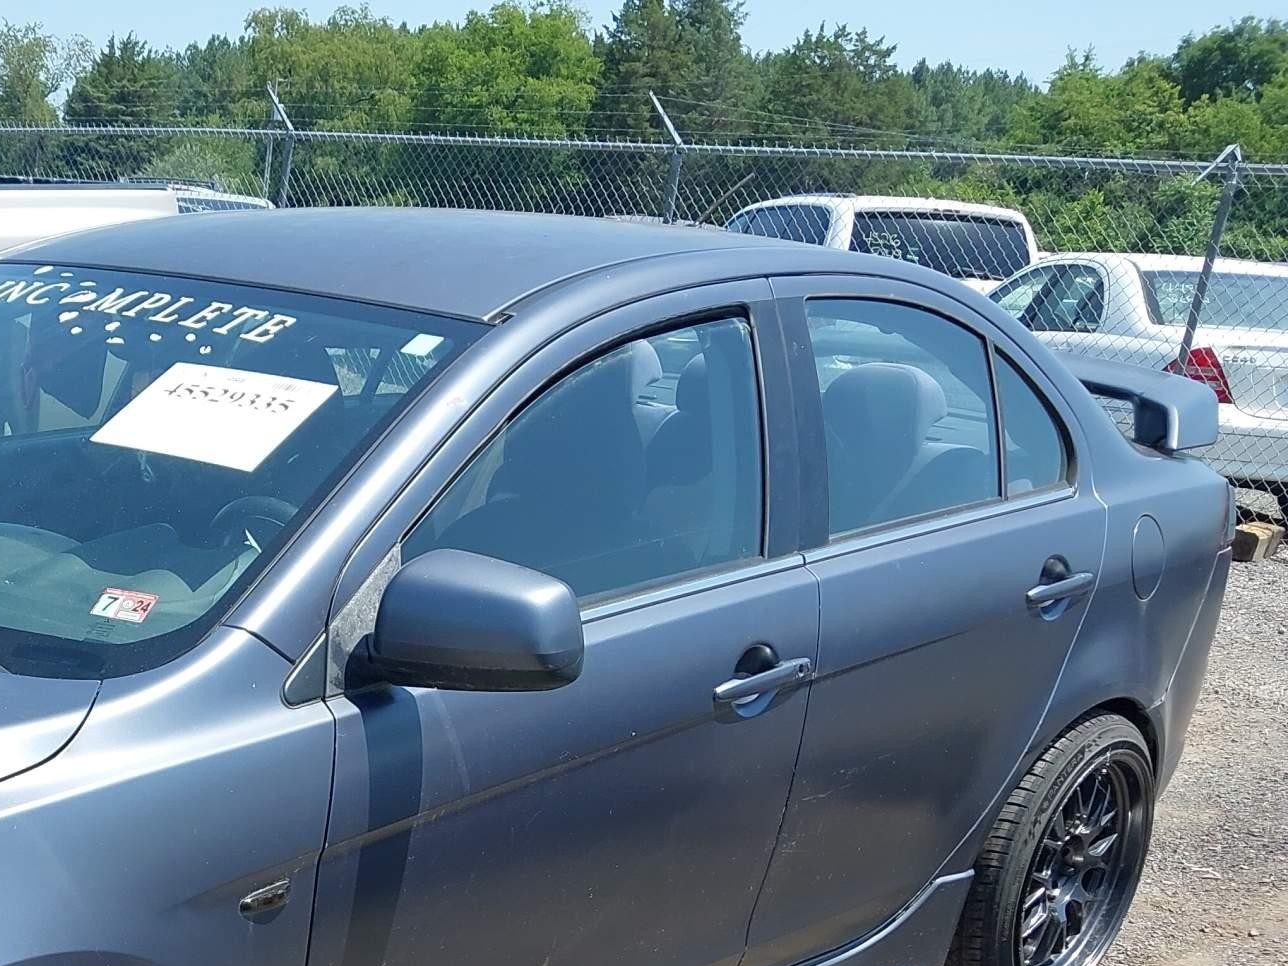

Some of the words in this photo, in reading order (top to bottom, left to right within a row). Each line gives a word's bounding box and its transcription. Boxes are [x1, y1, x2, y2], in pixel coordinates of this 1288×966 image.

[163, 382, 296, 413] 45529335
[101, 595, 120, 612] 7
[131, 600, 152, 613] 24
